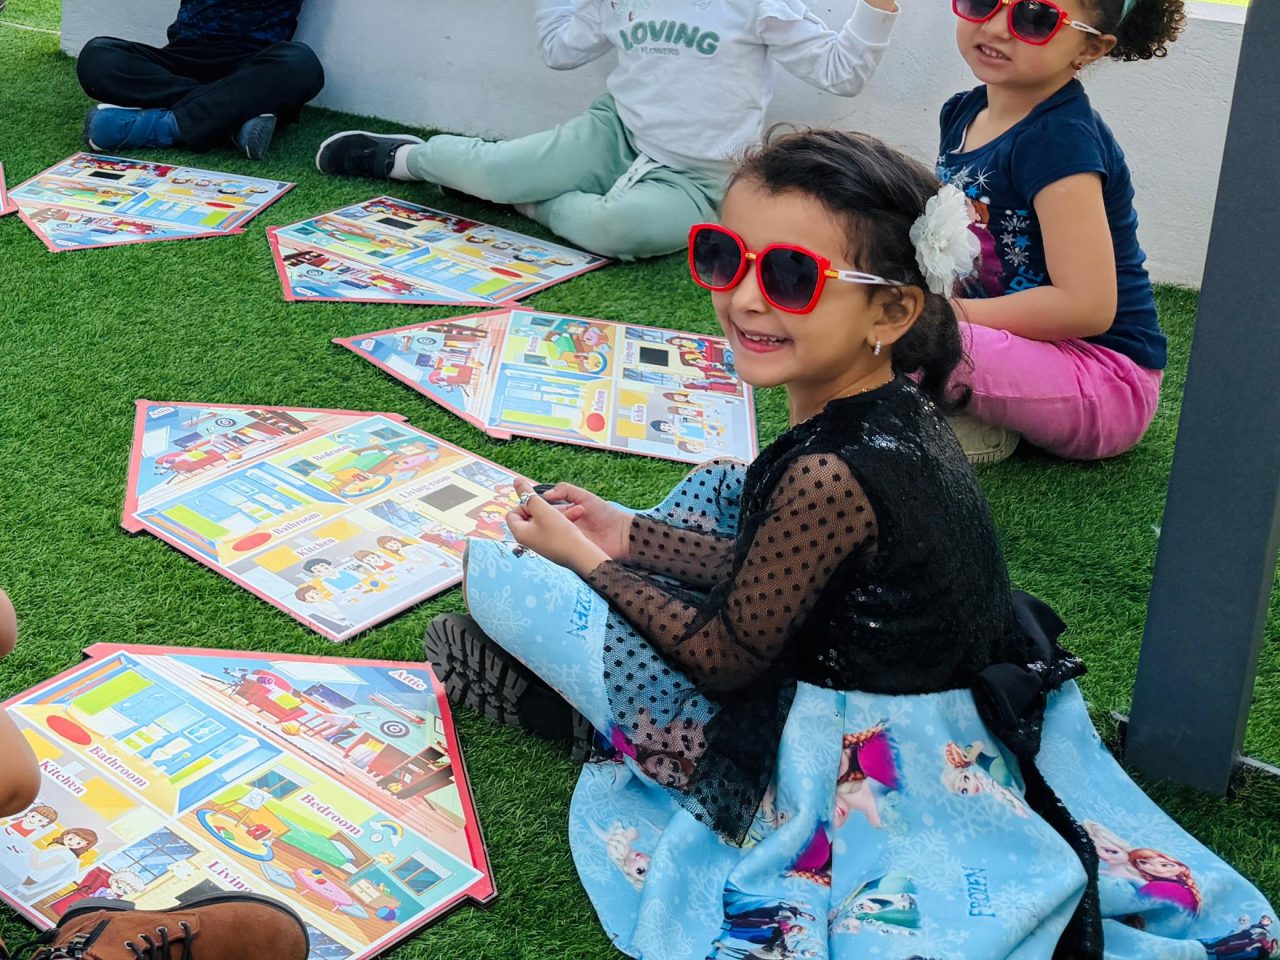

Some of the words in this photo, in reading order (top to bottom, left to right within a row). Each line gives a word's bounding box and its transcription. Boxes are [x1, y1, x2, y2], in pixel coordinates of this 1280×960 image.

[619, 20, 720, 55] LOVING
[312, 443, 353, 462] Bedroom
[272, 511, 321, 536] Bathroom
[296, 538, 335, 558] Kitchen
[566, 583, 592, 640] OZEN
[391, 670, 426, 689] Attic
[39, 760, 84, 795] Kitchen
[89, 745, 148, 788] Bathroom
[300, 793, 363, 836] Bedroom
[962, 866, 996, 917] FROZEN
